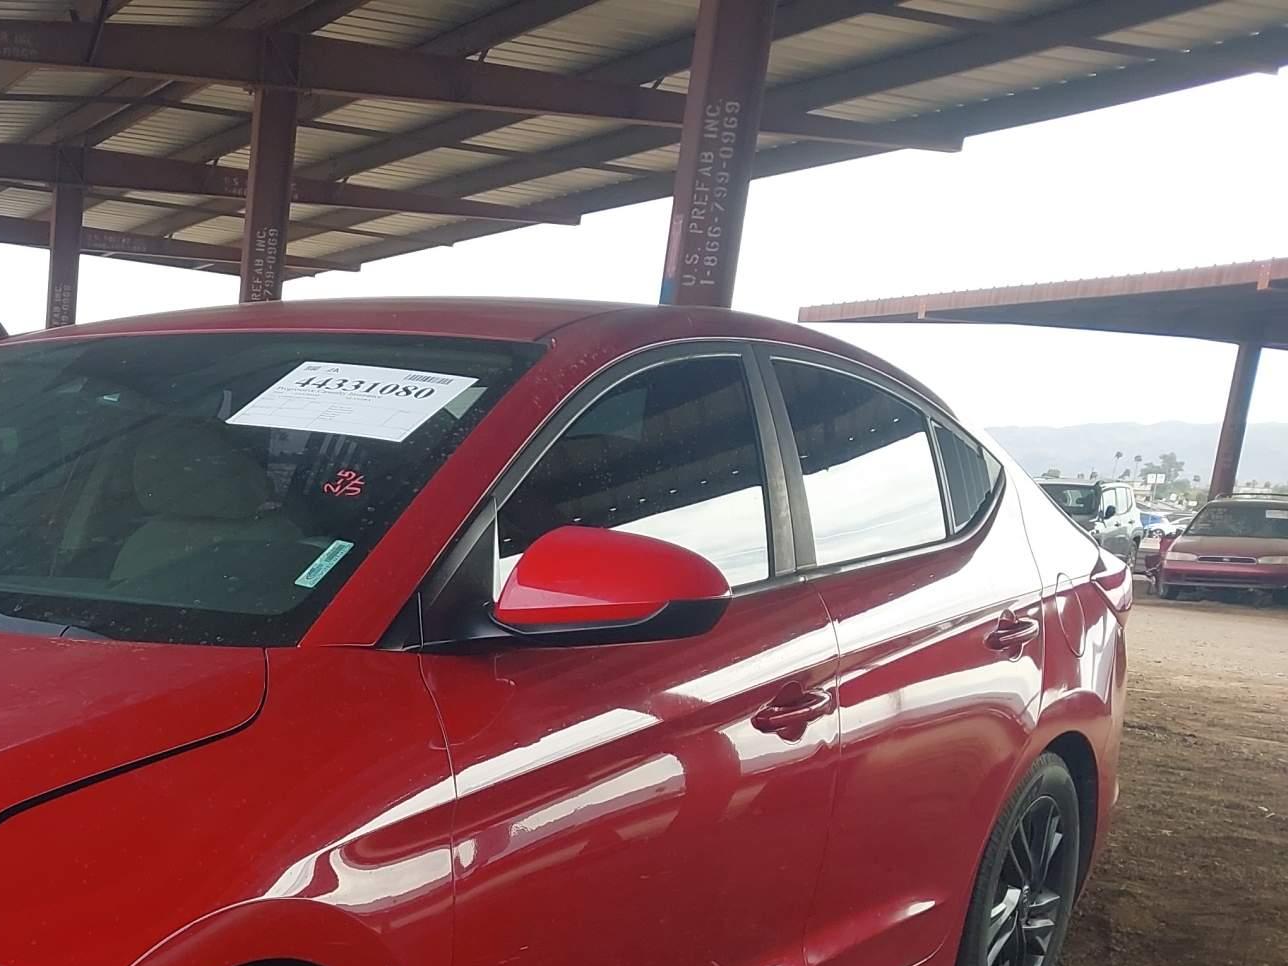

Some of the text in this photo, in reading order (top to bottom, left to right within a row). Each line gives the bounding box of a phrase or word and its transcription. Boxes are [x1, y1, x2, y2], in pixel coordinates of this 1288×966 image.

[682, 98, 723, 286] U.S. PREFAB INC.
[700, 101, 740, 285] 1-866-799-0969
[252, 227, 268, 300] REFAB INC.
[295, 376, 435, 400] 44331080
